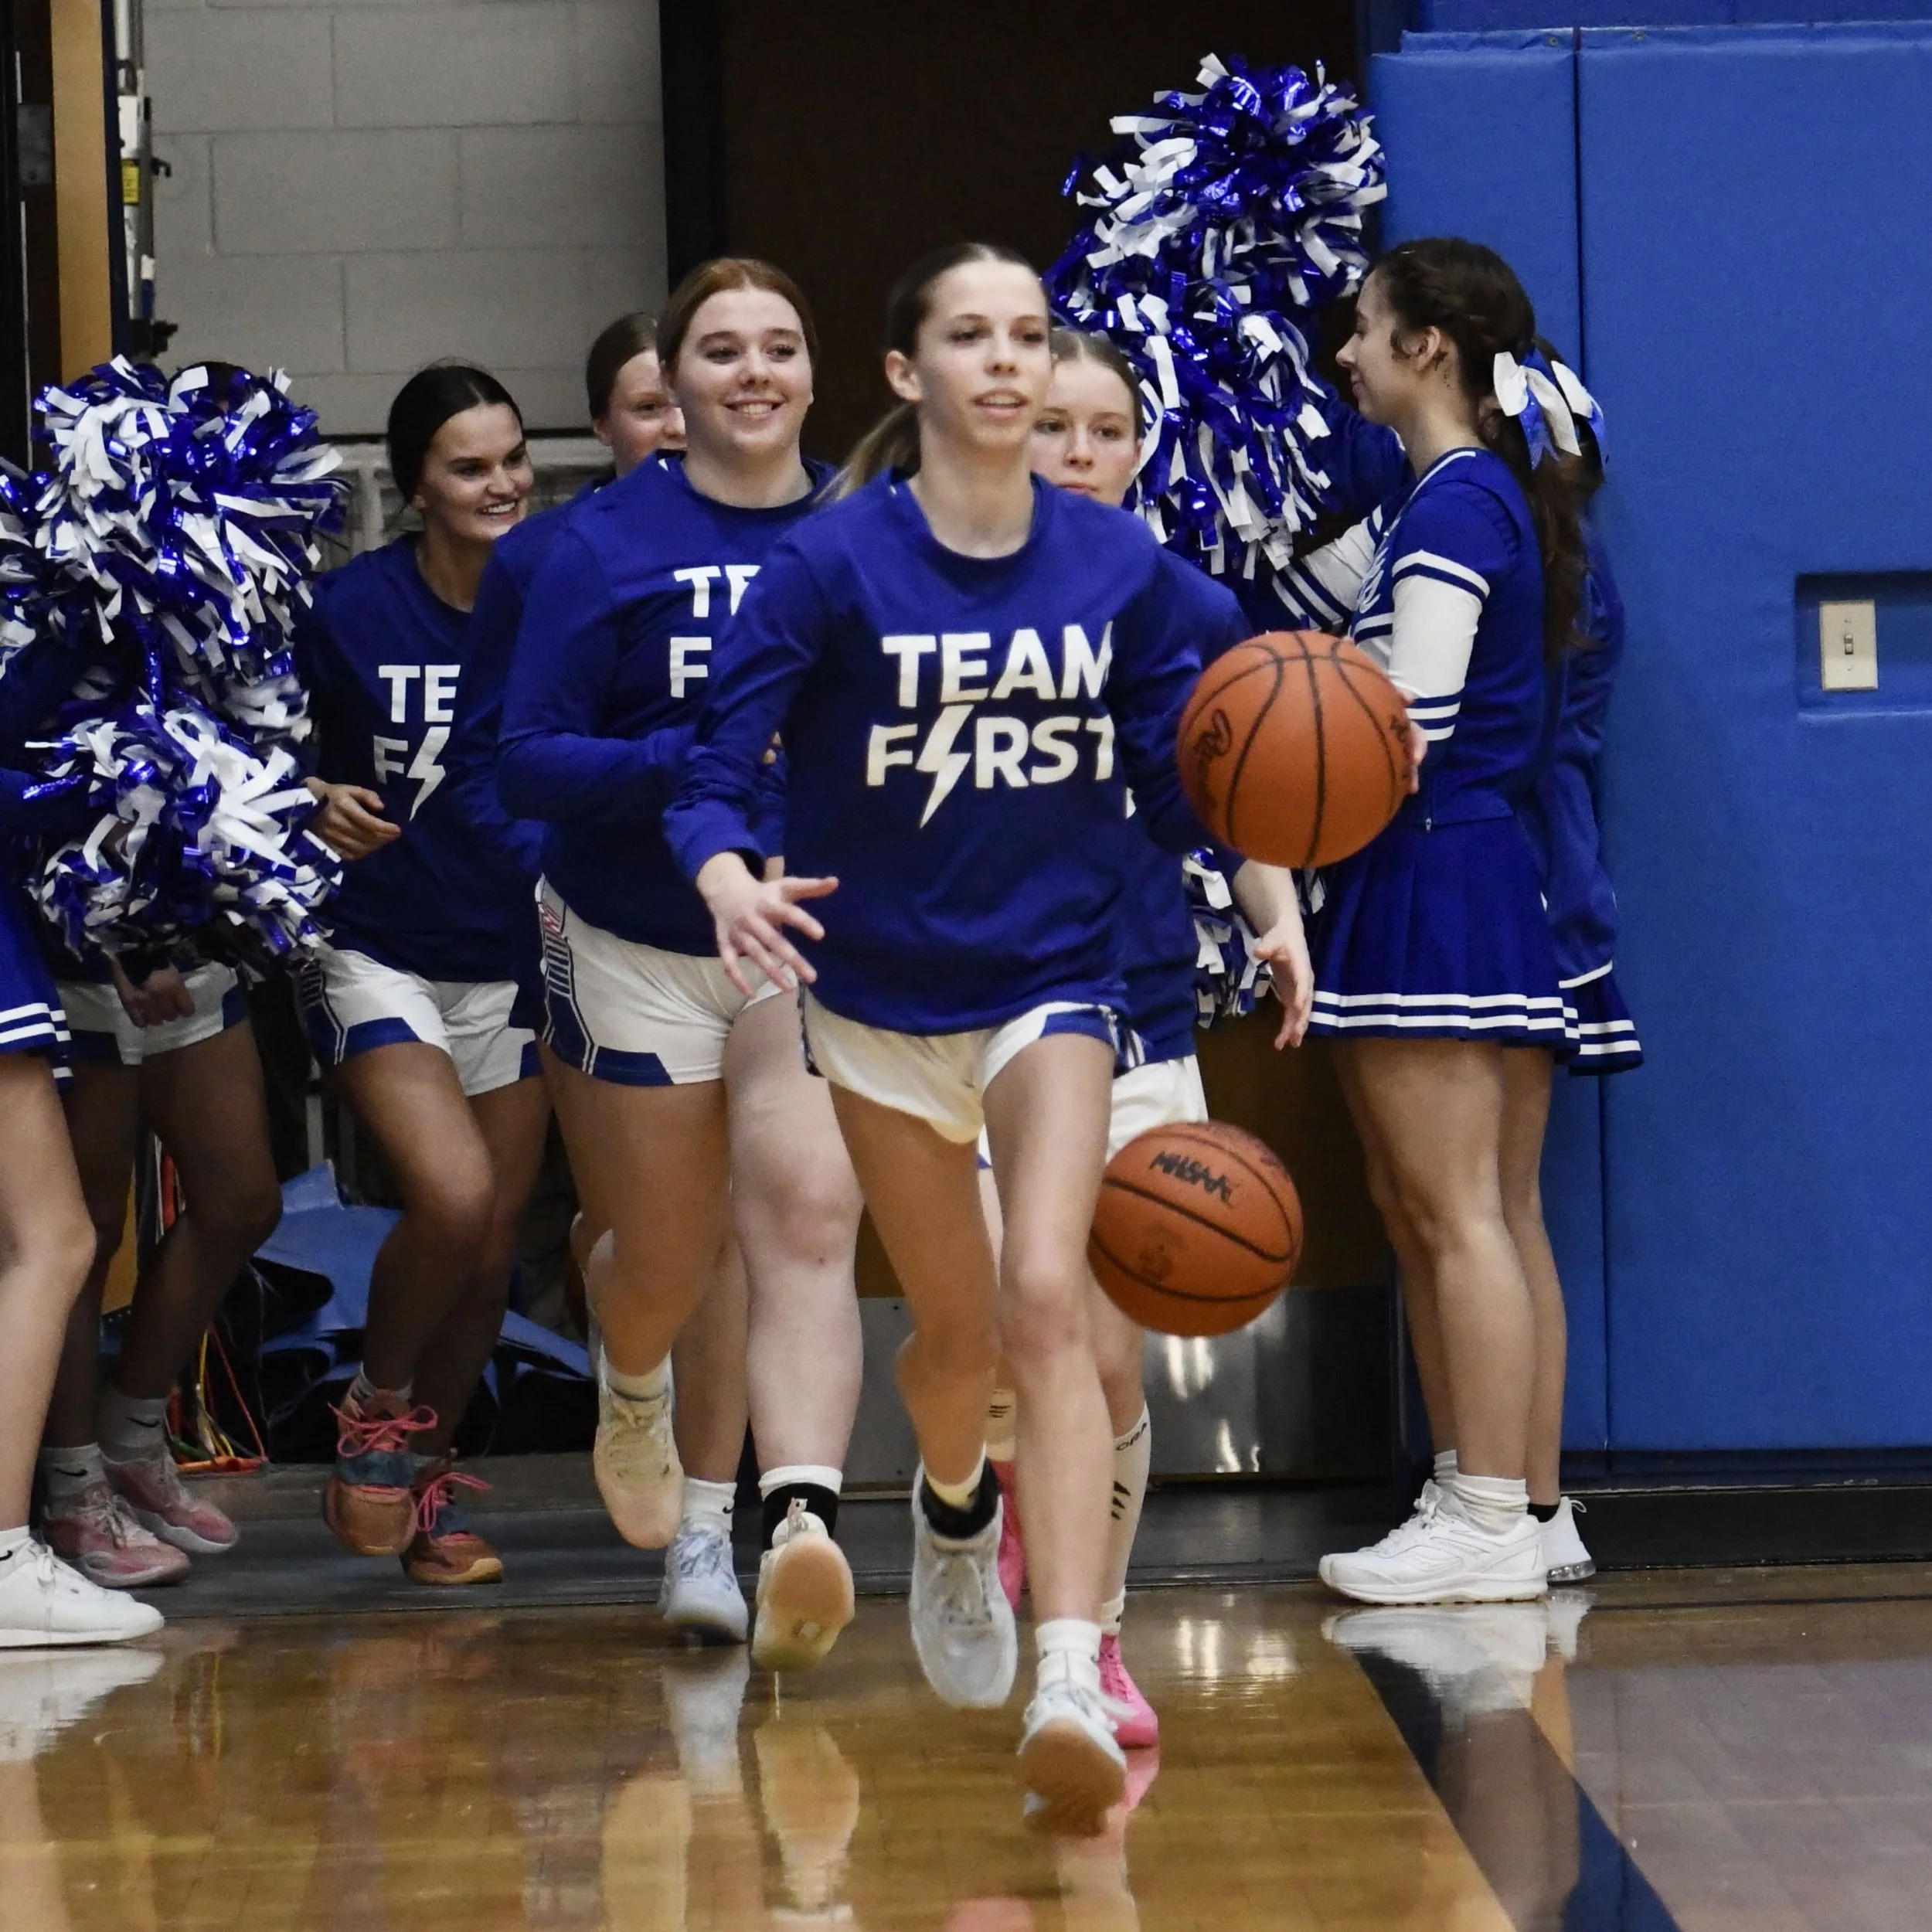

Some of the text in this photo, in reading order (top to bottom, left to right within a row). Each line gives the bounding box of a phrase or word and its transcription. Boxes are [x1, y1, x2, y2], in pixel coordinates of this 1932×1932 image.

[674, 565, 761, 617] TE
[882, 621, 1114, 708] TEAM
[379, 665, 461, 723] TE
